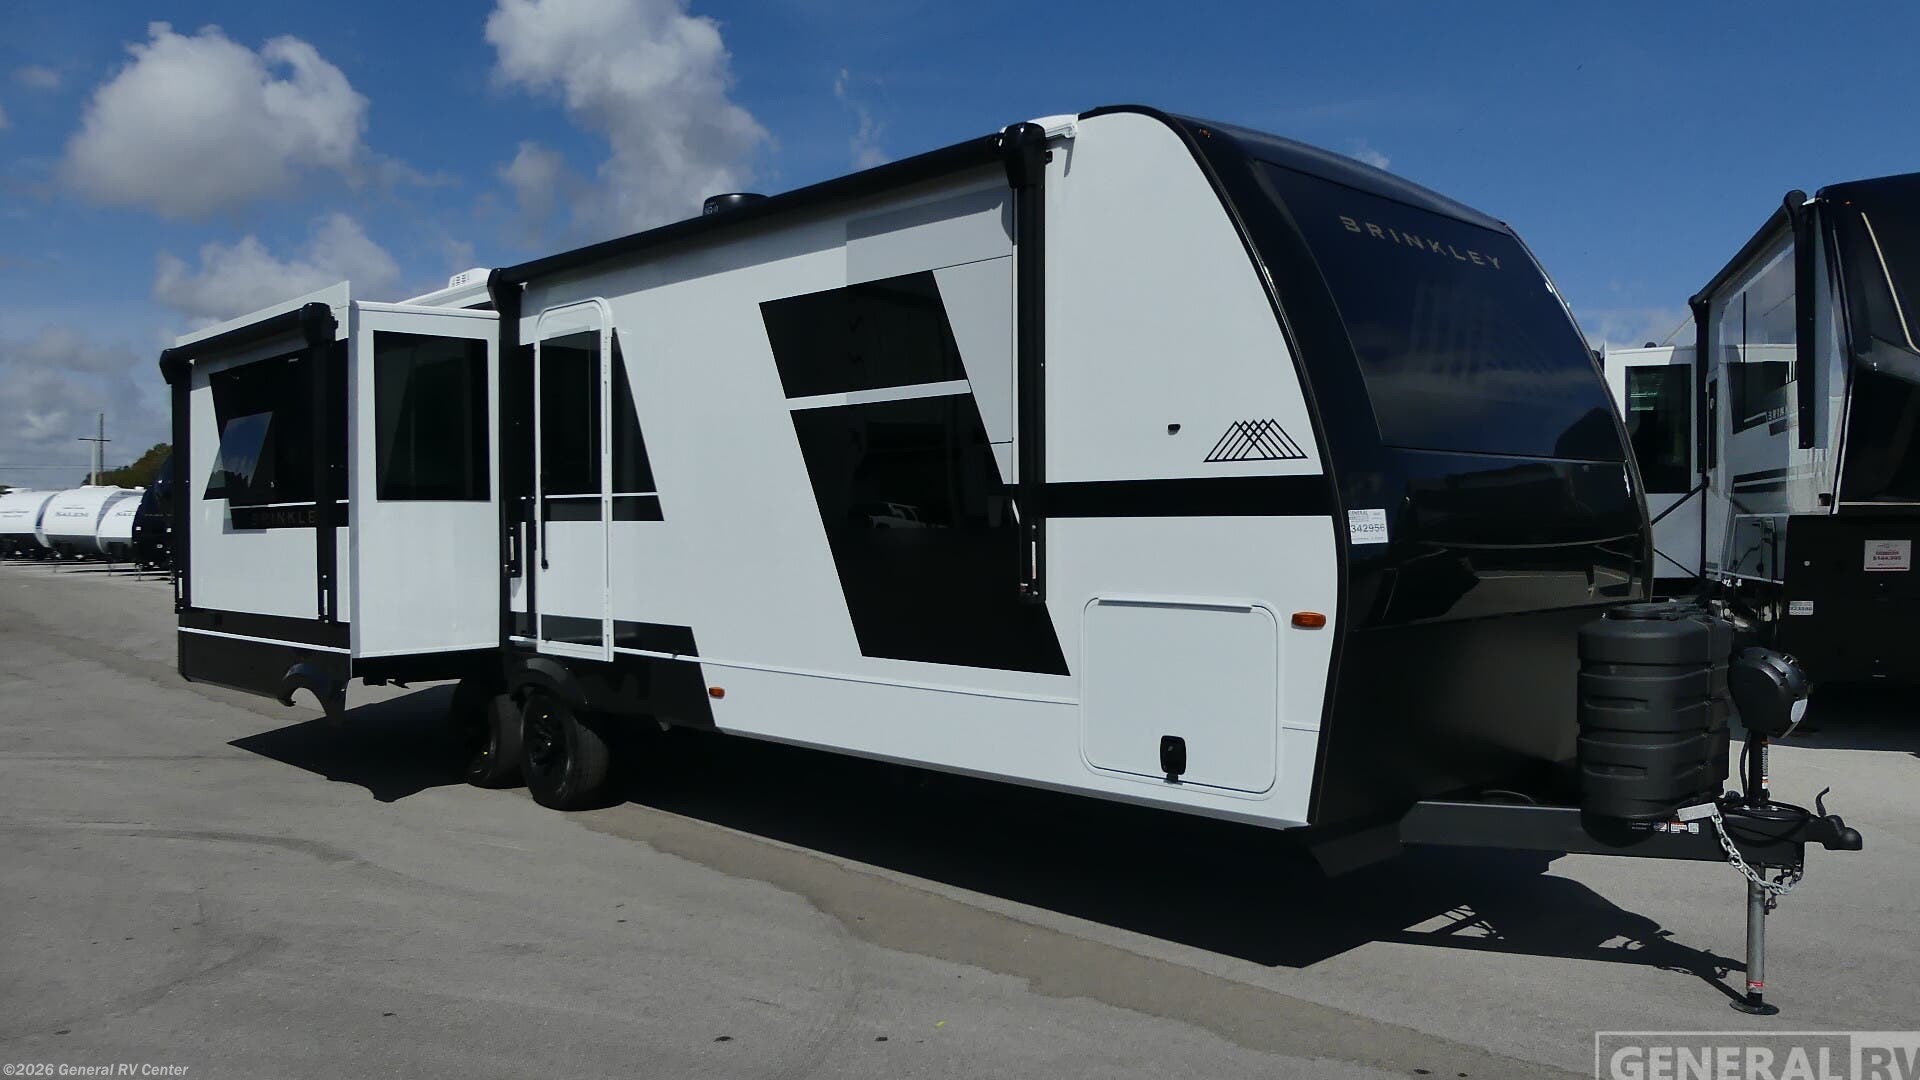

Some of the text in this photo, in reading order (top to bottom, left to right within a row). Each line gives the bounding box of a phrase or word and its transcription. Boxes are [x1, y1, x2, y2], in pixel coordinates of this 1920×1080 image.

[1339, 215, 1501, 270] BRINKLEY
[251, 510, 318, 526] BRINKLE
[1350, 524, 1385, 533] 342956
